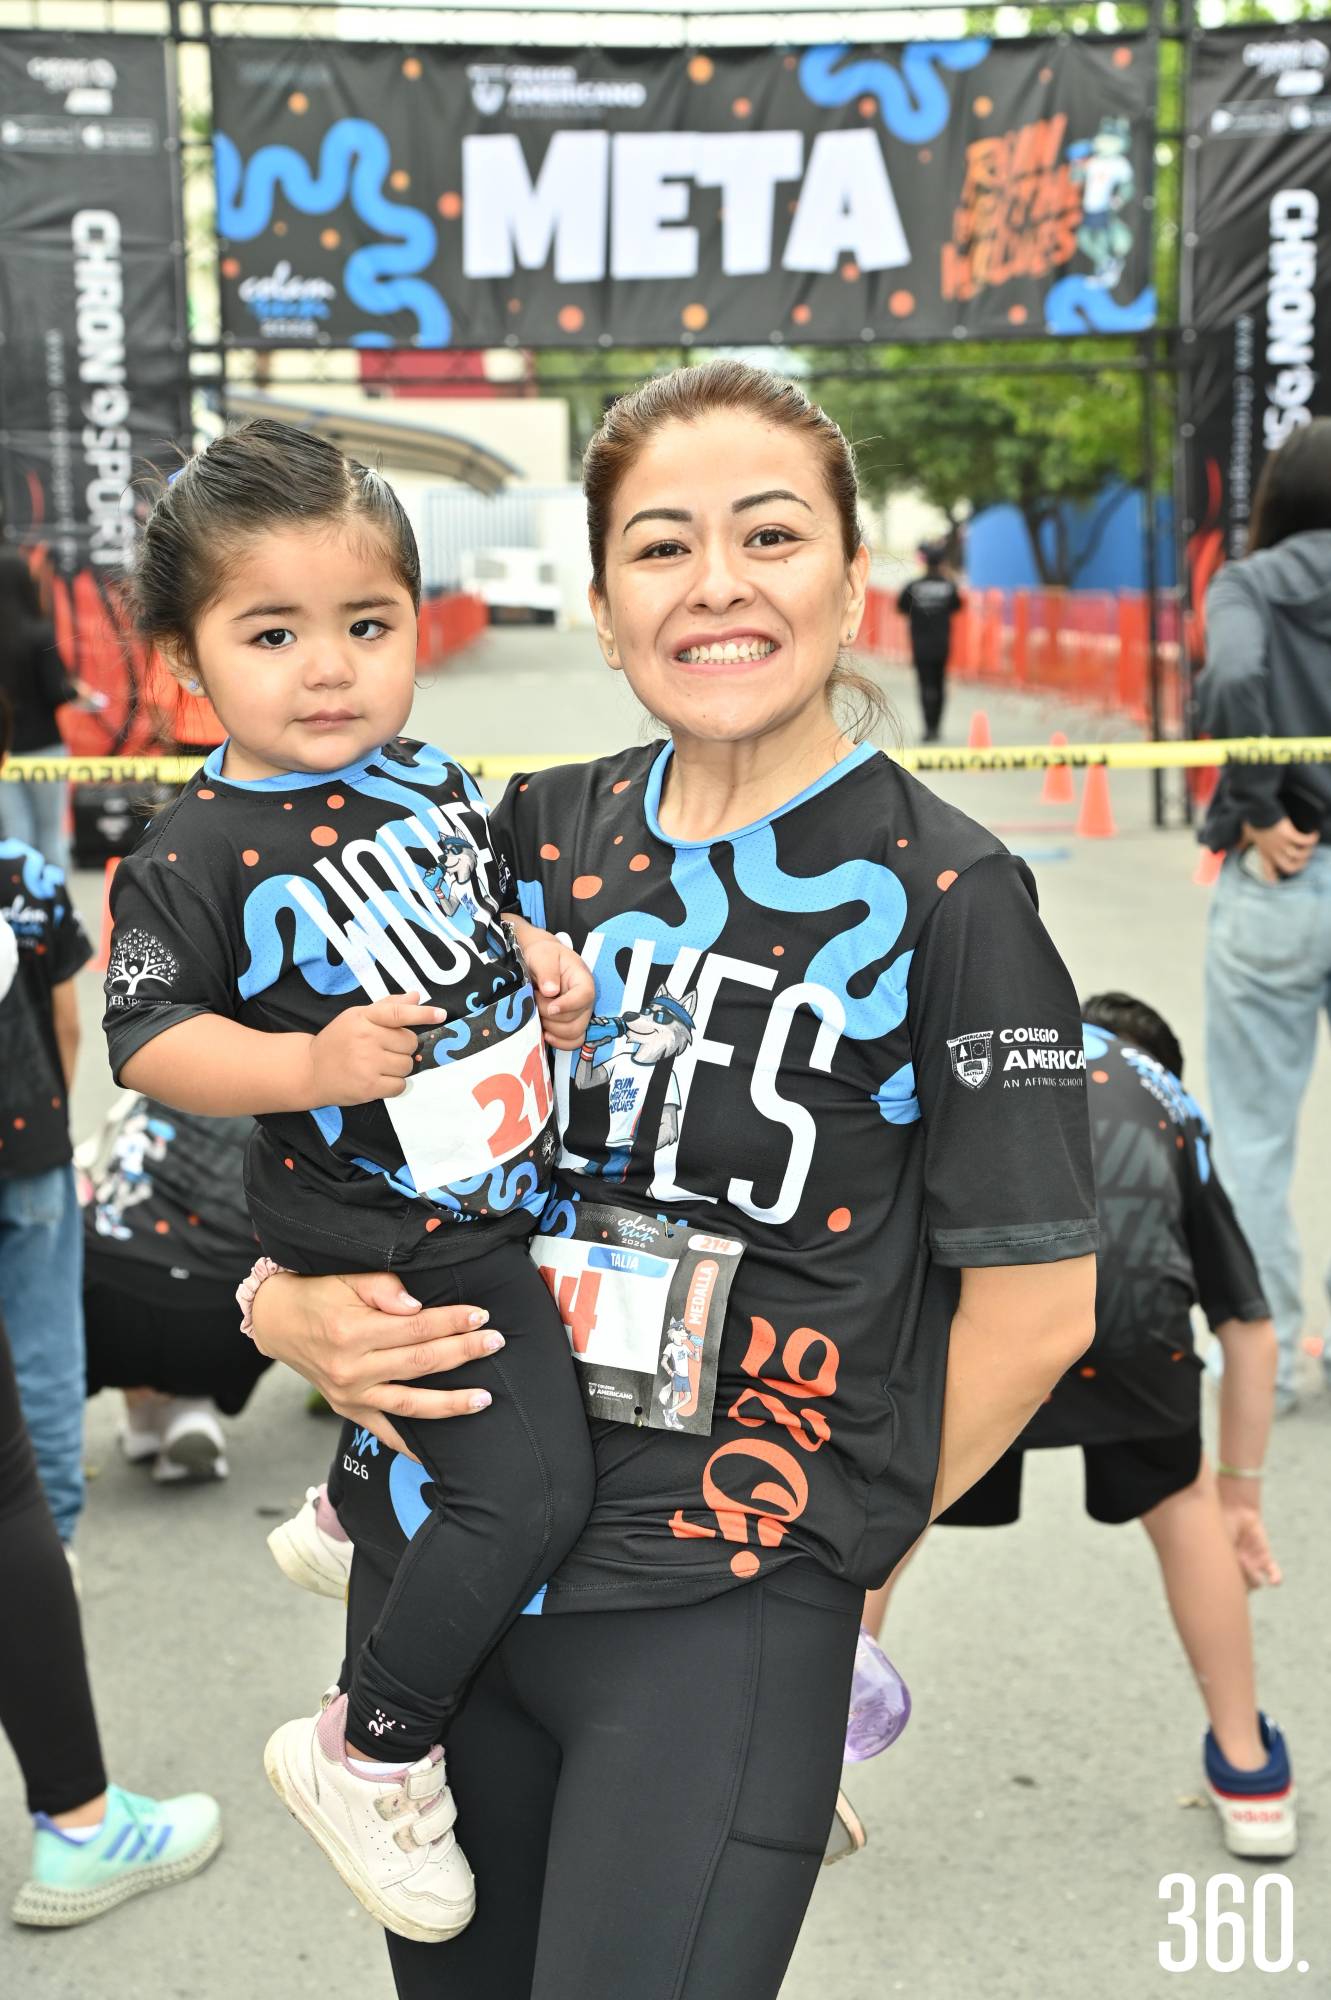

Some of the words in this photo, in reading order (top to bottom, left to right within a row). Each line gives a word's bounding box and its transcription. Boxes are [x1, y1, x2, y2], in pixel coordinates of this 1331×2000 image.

[462, 127, 911, 284] META
[1263, 188, 1319, 451] CHRONOS
[1000, 1027, 1059, 1044] COLEGIO
[1002, 1048, 1087, 1072] AMERICA
[1003, 1079, 1020, 1089] AN
[471, 1043, 554, 1160] 21
[621, 1237, 647, 1249] 2026
[699, 1237, 731, 1252] 214
[610, 1252, 641, 1271] TALIA
[688, 1265, 715, 1325] MEDALLA
